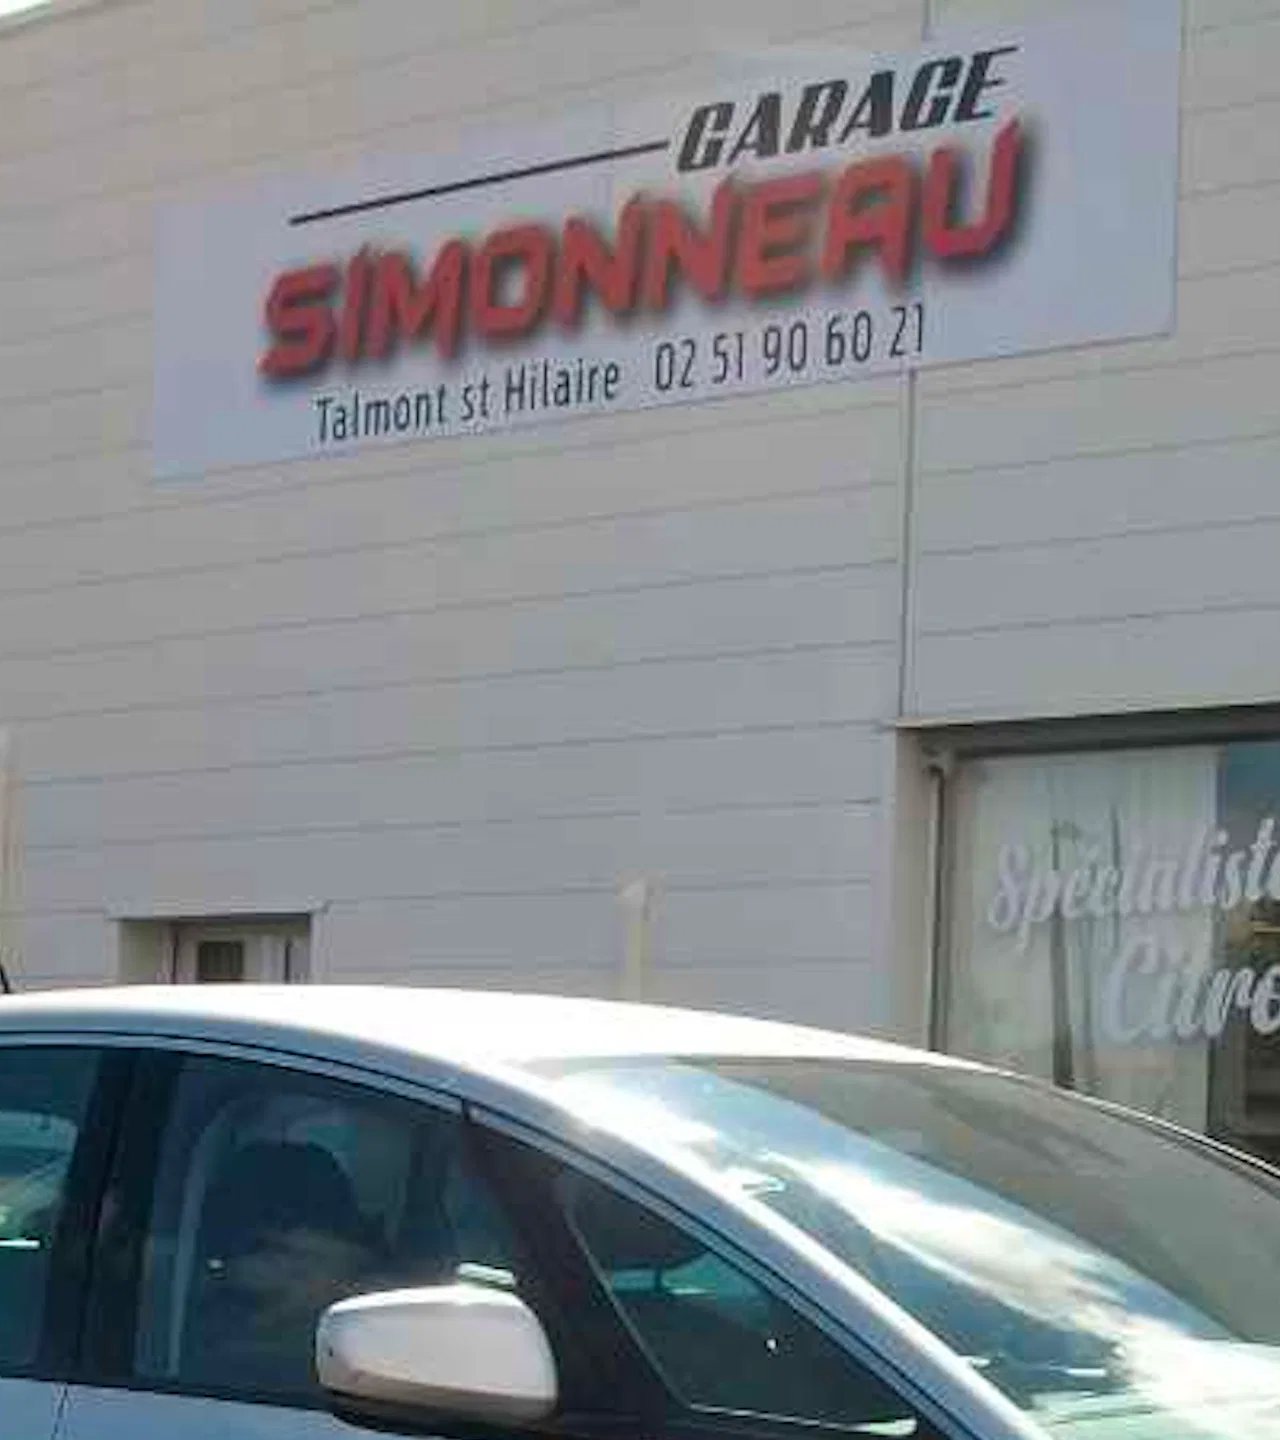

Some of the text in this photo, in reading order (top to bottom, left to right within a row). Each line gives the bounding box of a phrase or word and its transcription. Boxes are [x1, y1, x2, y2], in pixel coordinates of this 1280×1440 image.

[676, 45, 1020, 173] GARAGE
[259, 118, 1026, 380] SIMONNEAU
[315, 301, 925, 442] Talmont st Hilaire 02 51 90 60 21
